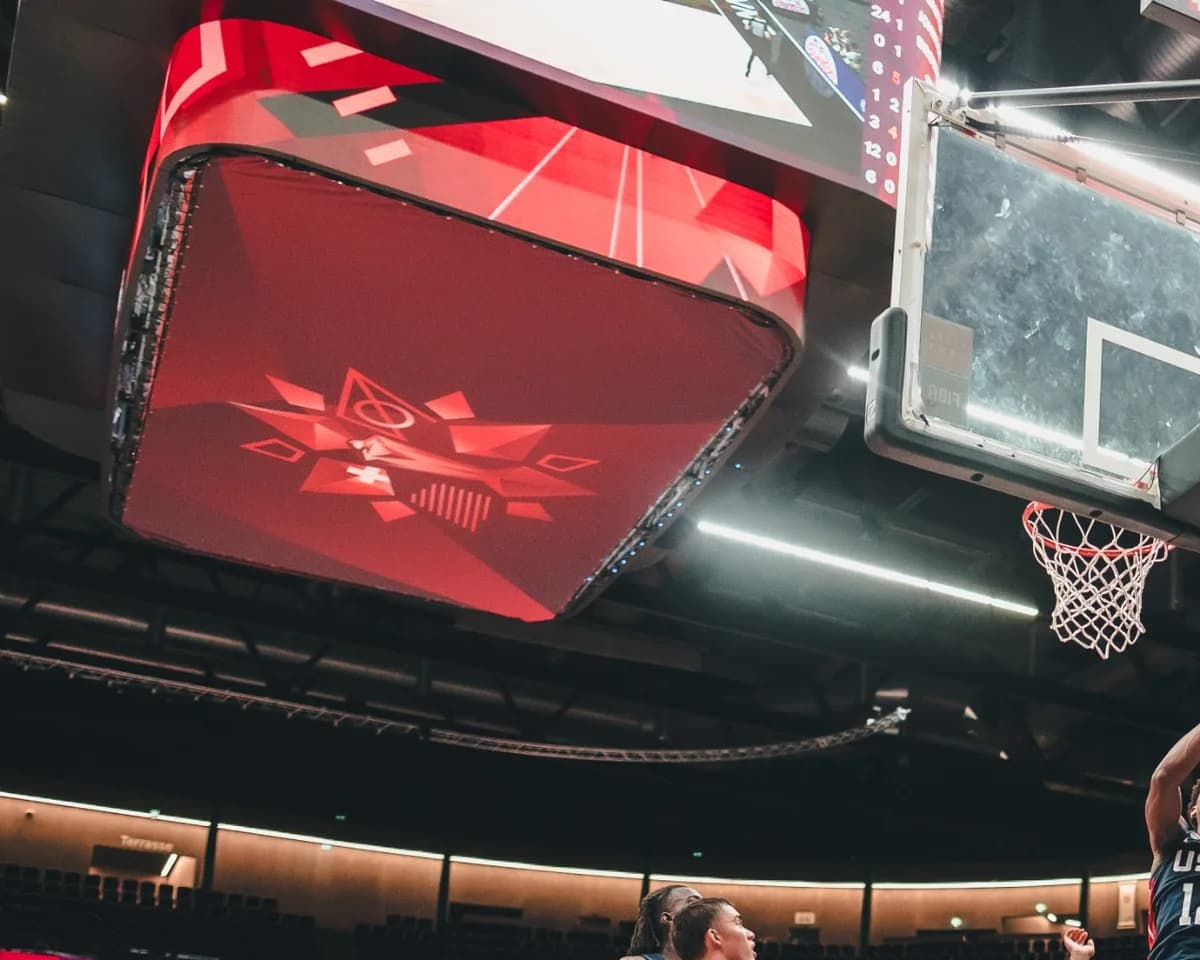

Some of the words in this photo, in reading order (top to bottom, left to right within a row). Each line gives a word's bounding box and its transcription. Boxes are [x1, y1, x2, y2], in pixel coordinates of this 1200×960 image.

[870, 4, 891, 23] 24
[873, 33, 886, 48] 0
[864, 140, 881, 159] 12
[119, 834, 174, 852] Terrasse
